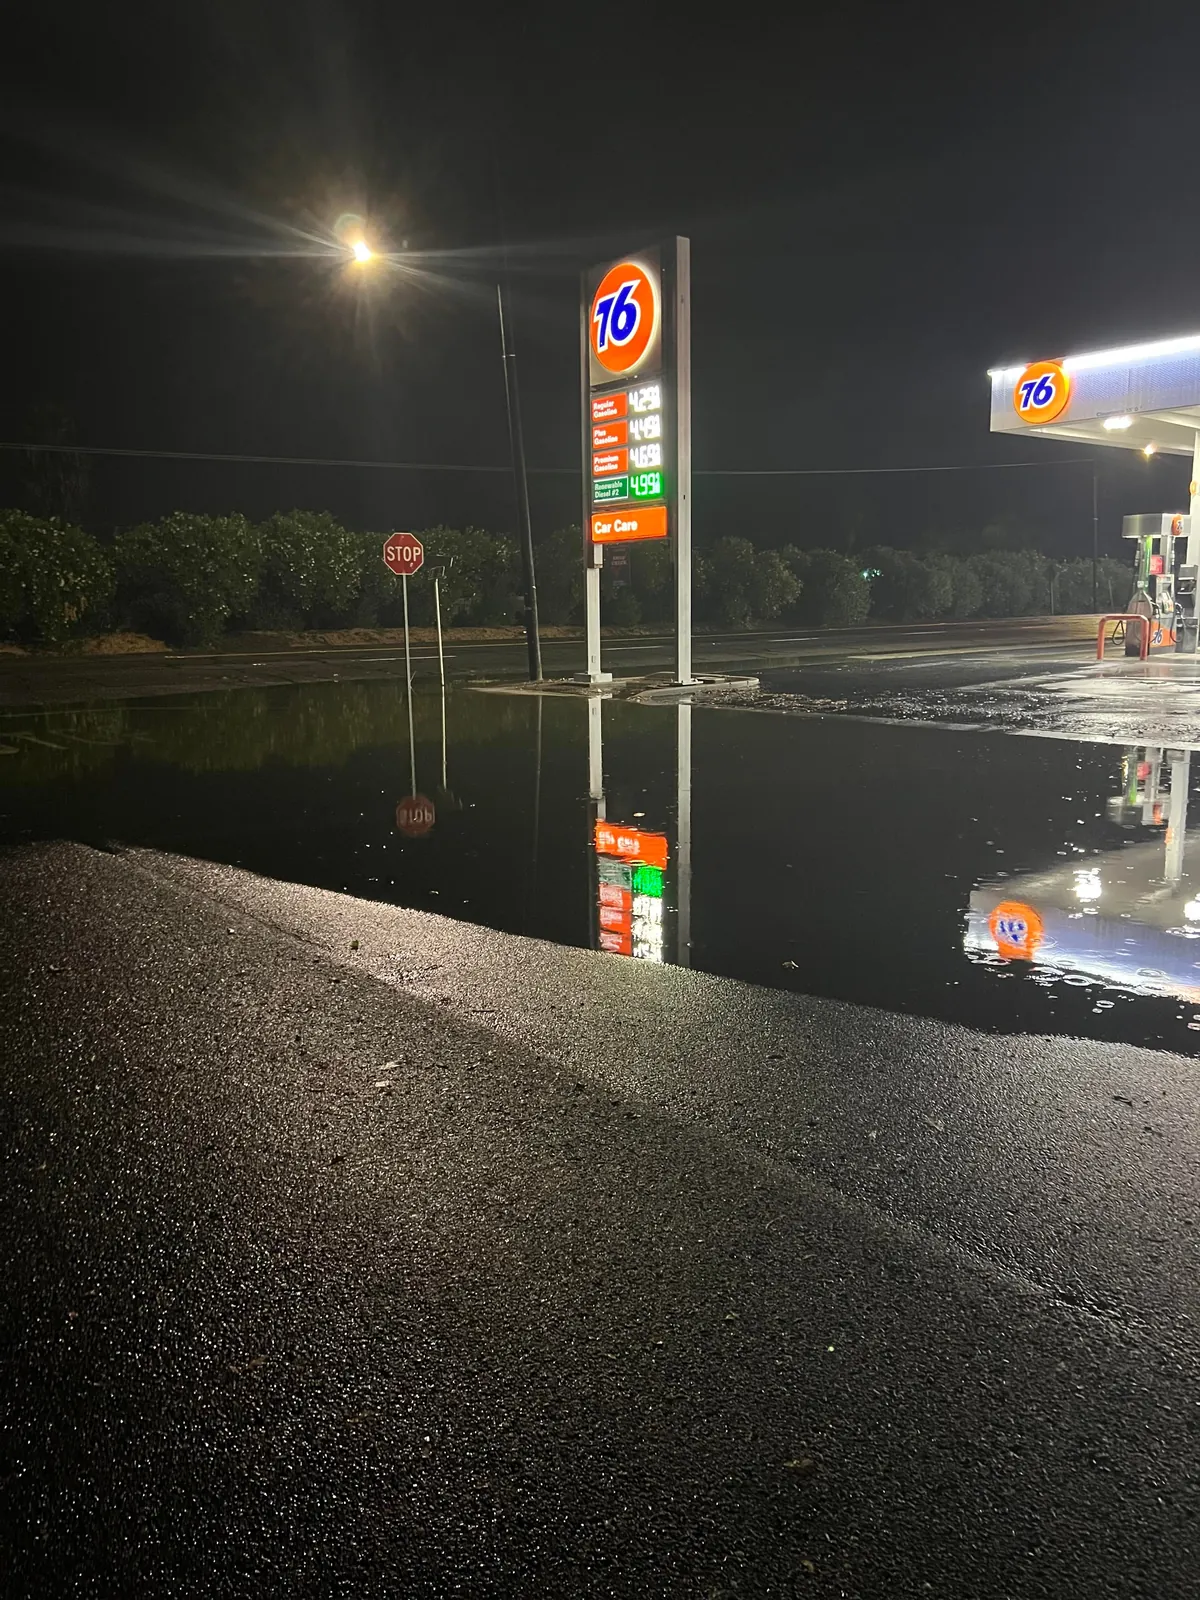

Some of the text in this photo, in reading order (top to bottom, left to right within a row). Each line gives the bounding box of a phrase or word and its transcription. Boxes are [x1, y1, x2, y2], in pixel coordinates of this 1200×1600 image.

[594, 279, 641, 353] 76
[1019, 373, 1056, 411] 76
[593, 400, 614, 410] Regular
[593, 408, 618, 418] Gasoline
[594, 429, 607, 437] Plus
[594, 435, 618, 445] Gasoline
[594, 455, 619, 464] Premium
[594, 463, 618, 472] Gasoline
[594, 481, 623, 490] Renewable
[594, 490, 611, 498] Diesel
[594, 519, 638, 534] Car Care
[386, 546, 421, 562] STOP
